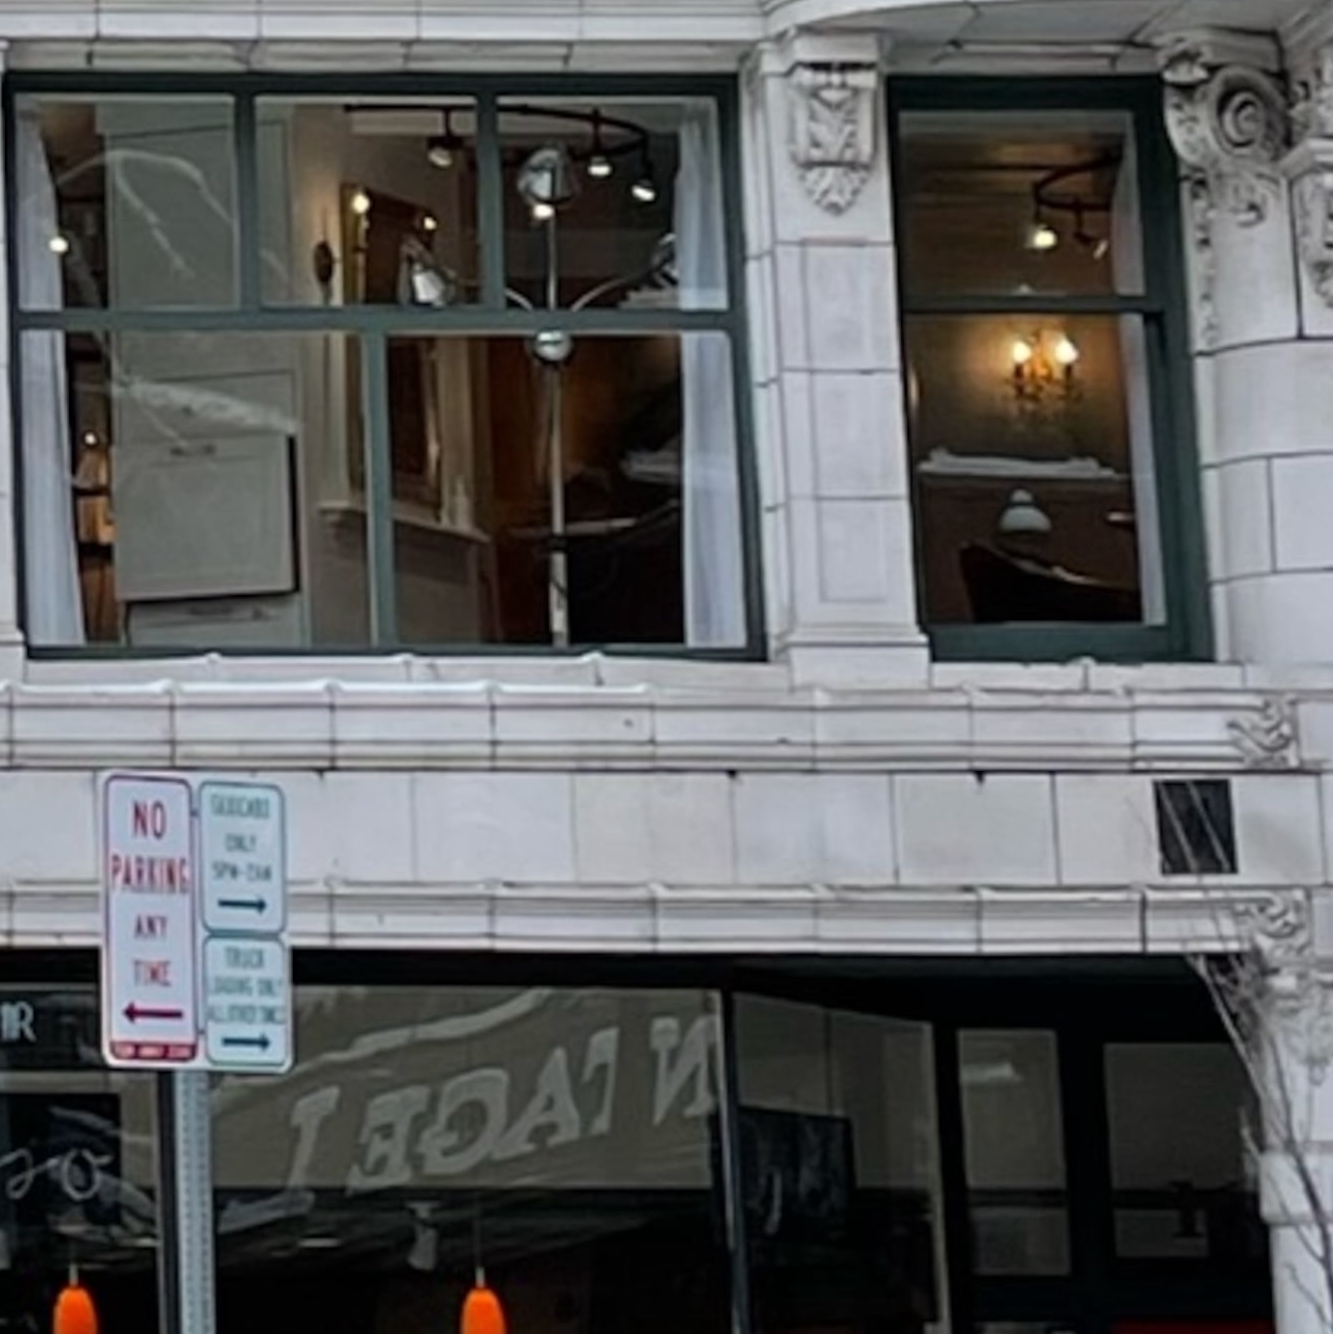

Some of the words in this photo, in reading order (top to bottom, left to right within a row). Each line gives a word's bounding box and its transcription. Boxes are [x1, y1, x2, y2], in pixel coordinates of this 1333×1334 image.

[132, 800, 167, 839] NO
[111, 855, 189, 894] PARKING
[134, 915, 168, 939] ANY
[133, 959, 171, 987] TIME
